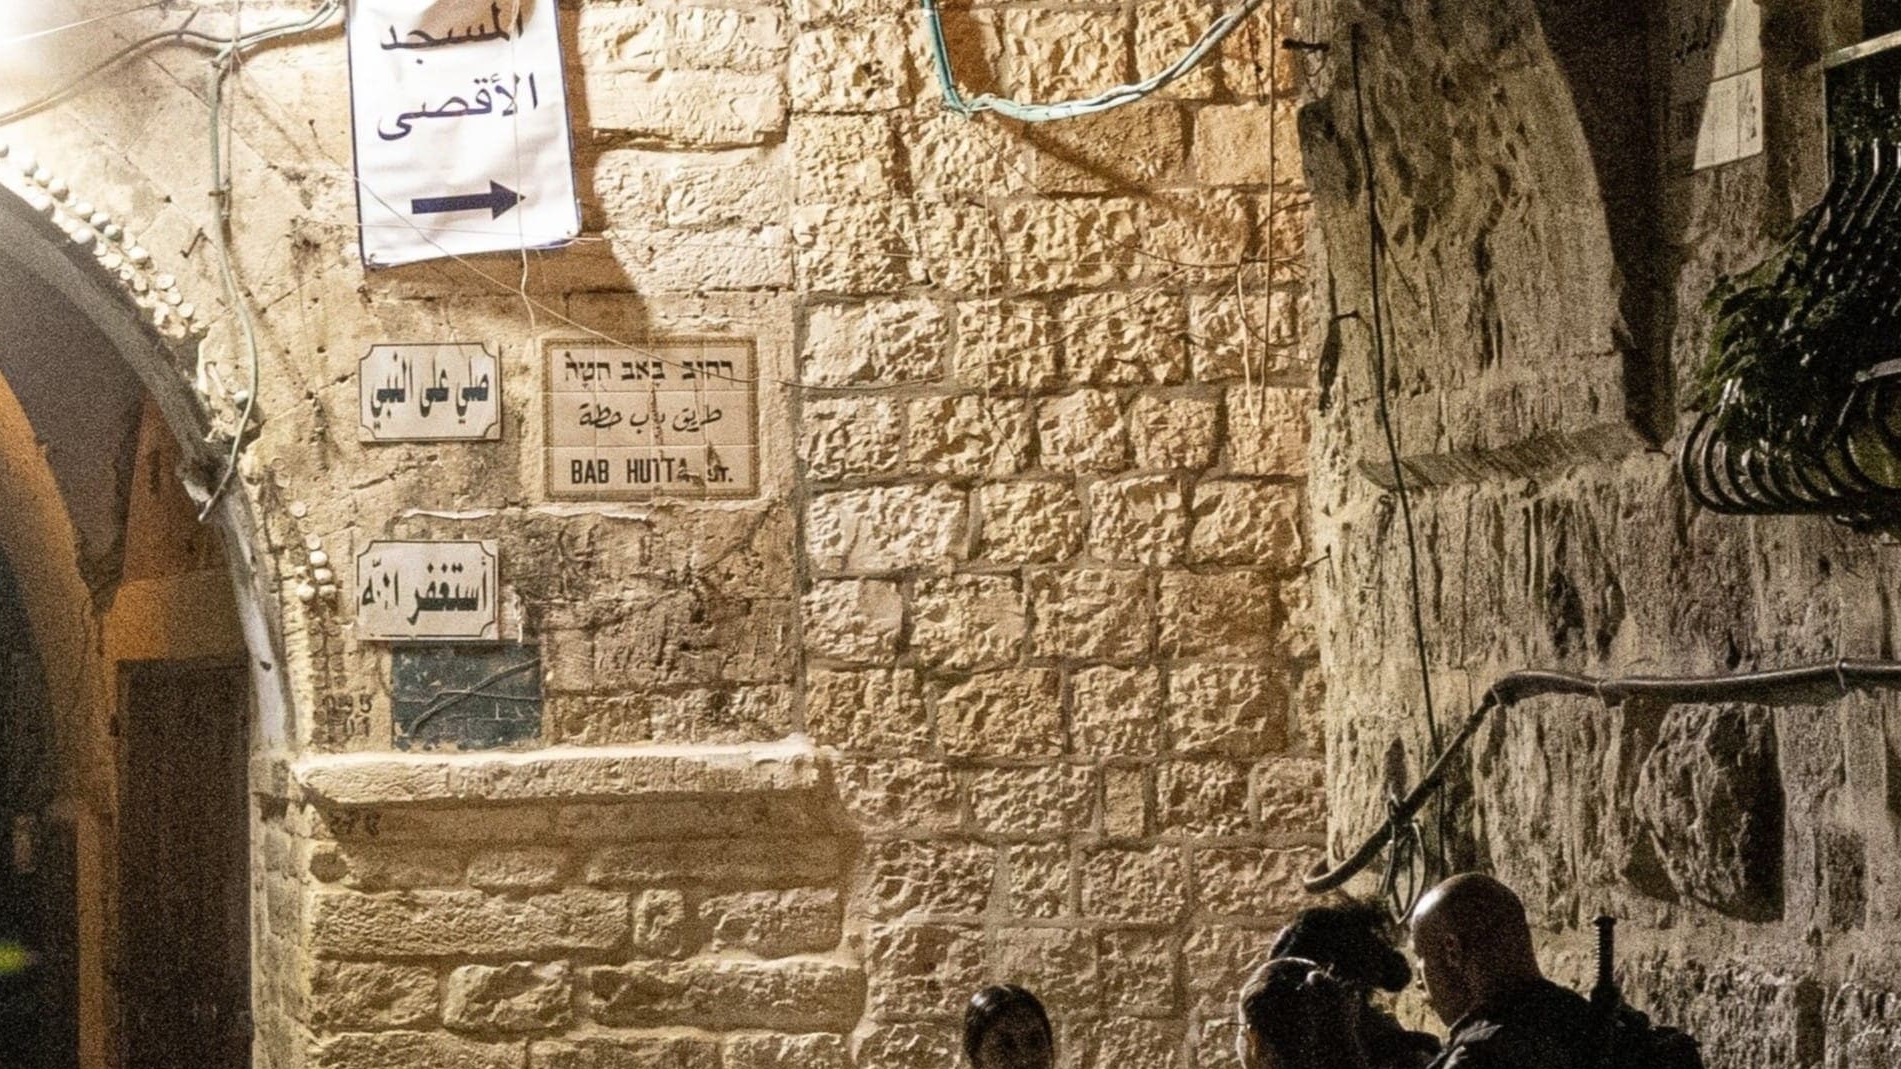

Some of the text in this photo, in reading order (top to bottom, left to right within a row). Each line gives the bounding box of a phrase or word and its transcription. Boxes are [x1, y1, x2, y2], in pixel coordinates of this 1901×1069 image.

[380, 2, 524, 64] المسجد
[378, 72, 538, 141] الأقصى
[682, 360, 733, 387] רחוב
[371, 351, 414, 431] النبي
[579, 403, 623, 429] حطة
[672, 404, 723, 432] طريق
[571, 459, 609, 484] BAB
[626, 457, 692, 483] HUTTA
